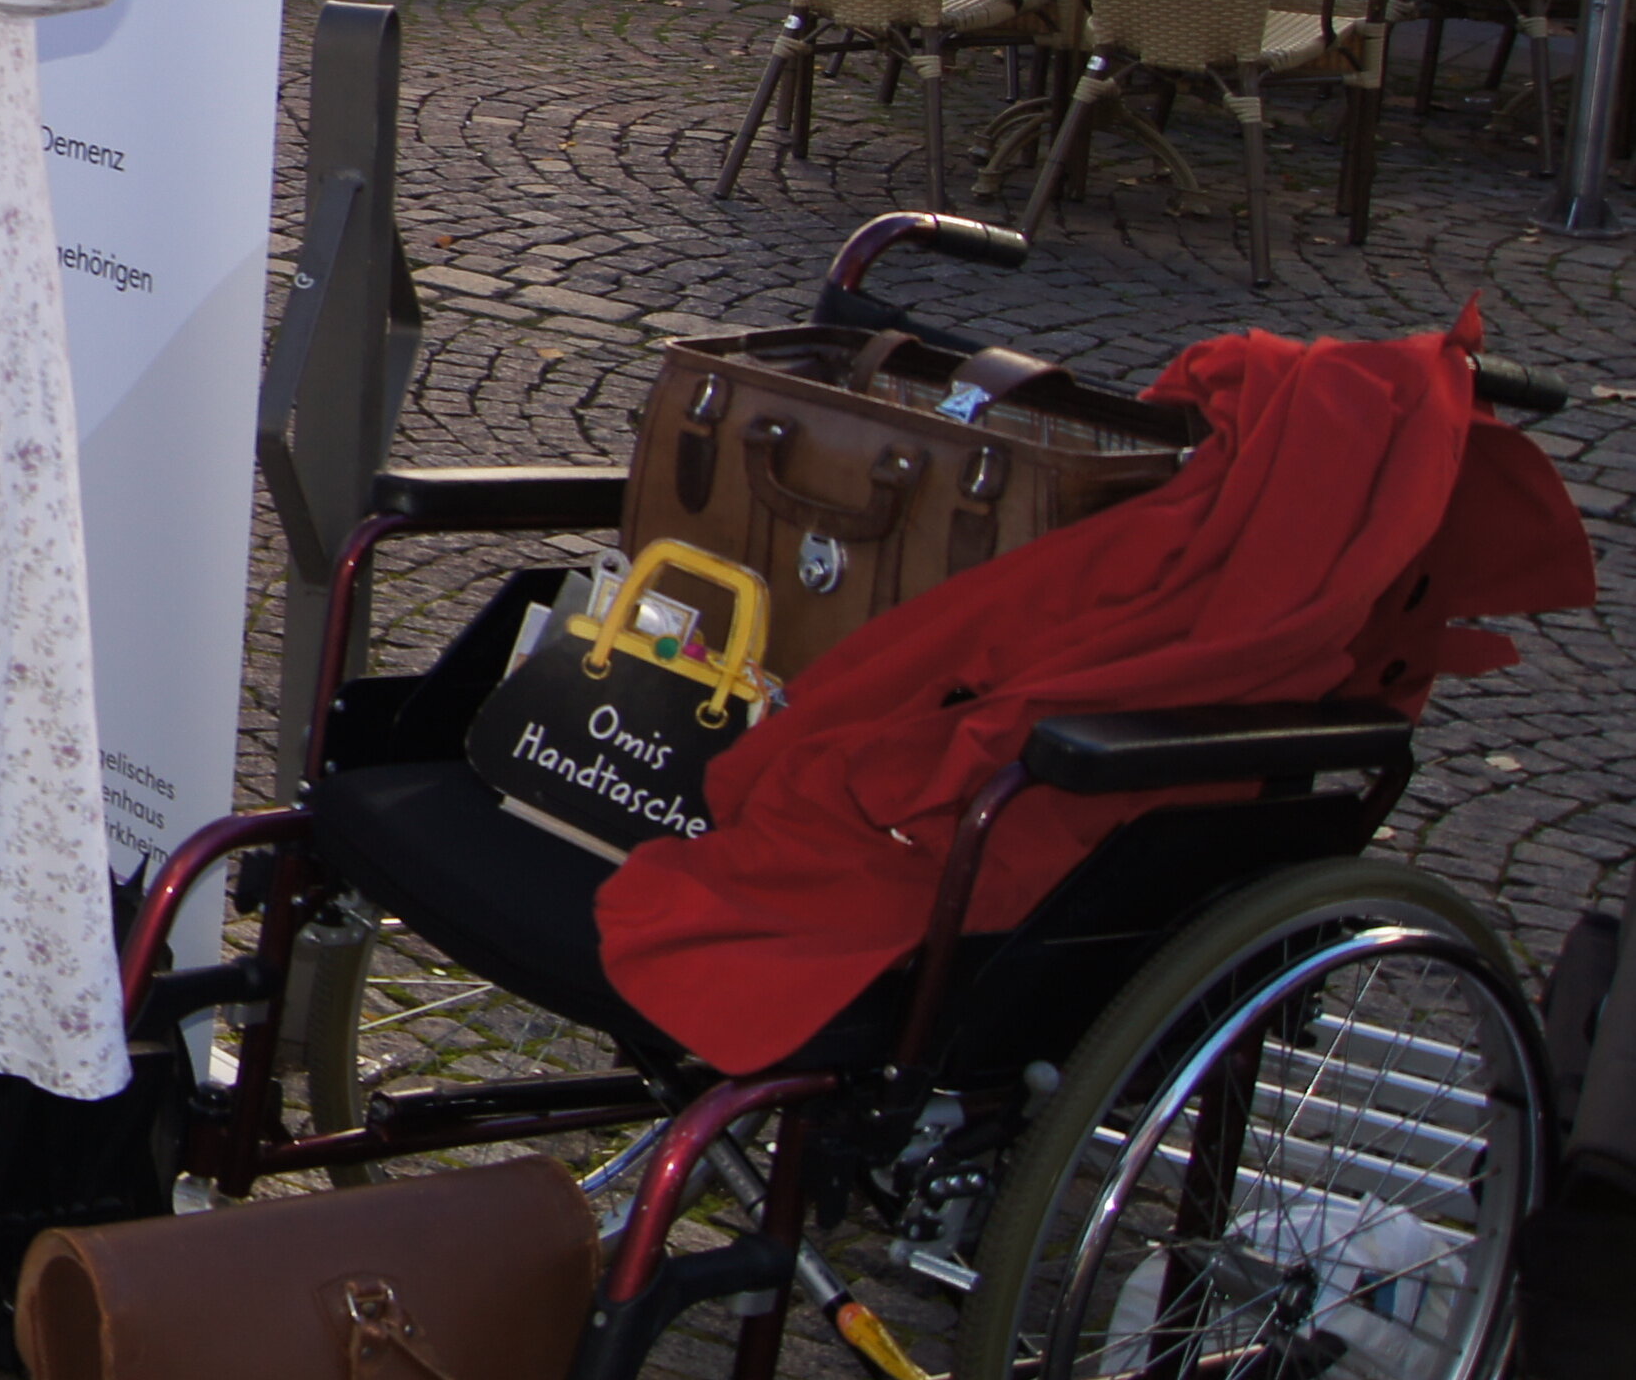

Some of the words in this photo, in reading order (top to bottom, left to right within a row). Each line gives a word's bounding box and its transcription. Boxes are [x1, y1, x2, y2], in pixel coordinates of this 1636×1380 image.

[41, 125, 125, 172] Demenz
[589, 704, 672, 770] Omis
[103, 783, 165, 830] enhaus
[513, 722, 707, 839] Handtasche
